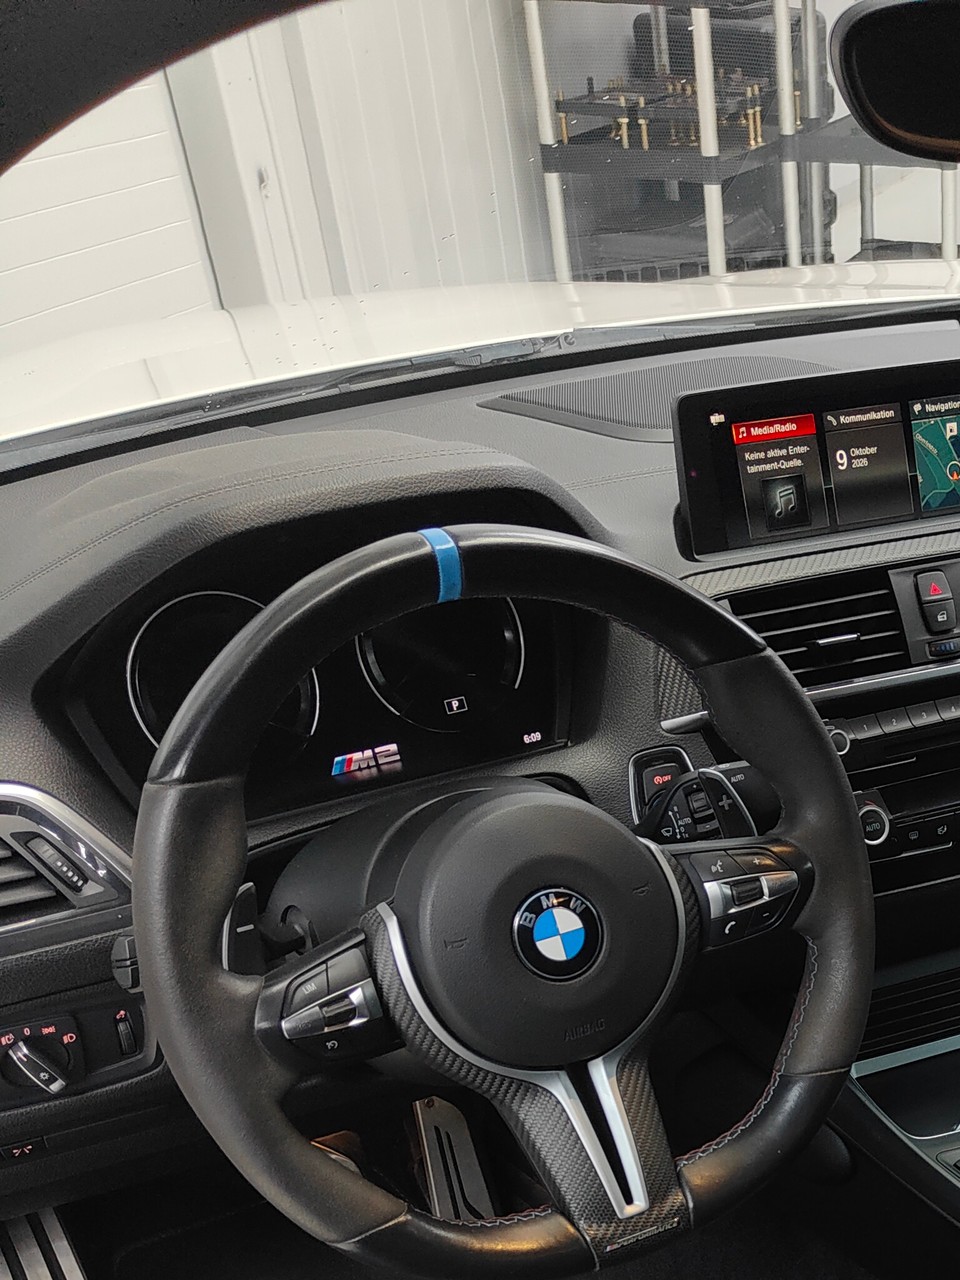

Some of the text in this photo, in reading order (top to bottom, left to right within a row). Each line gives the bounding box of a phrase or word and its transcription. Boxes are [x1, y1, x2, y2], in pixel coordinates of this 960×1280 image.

[839, 409, 895, 425] Kommunikation
[750, 422, 797, 436] Media/Radio
[744, 445, 810, 461] Keine aktive Enter-
[850, 446, 877, 457] Oktober
[746, 458, 804, 474] tainment-Quelle.
[835, 449, 848, 470] 9
[451, 700, 459, 711] P
[523, 731, 541, 744] 6:09
[662, 774, 672, 782] OFF
[730, 773, 745, 783] AUTO
[678, 817, 692, 826] AUTO
[865, 822, 880, 832] AUTO
[519, 893, 587, 928] BMW
[301, 982, 318, 995] LIM
[562, 1018, 606, 1042] AIRBAG
